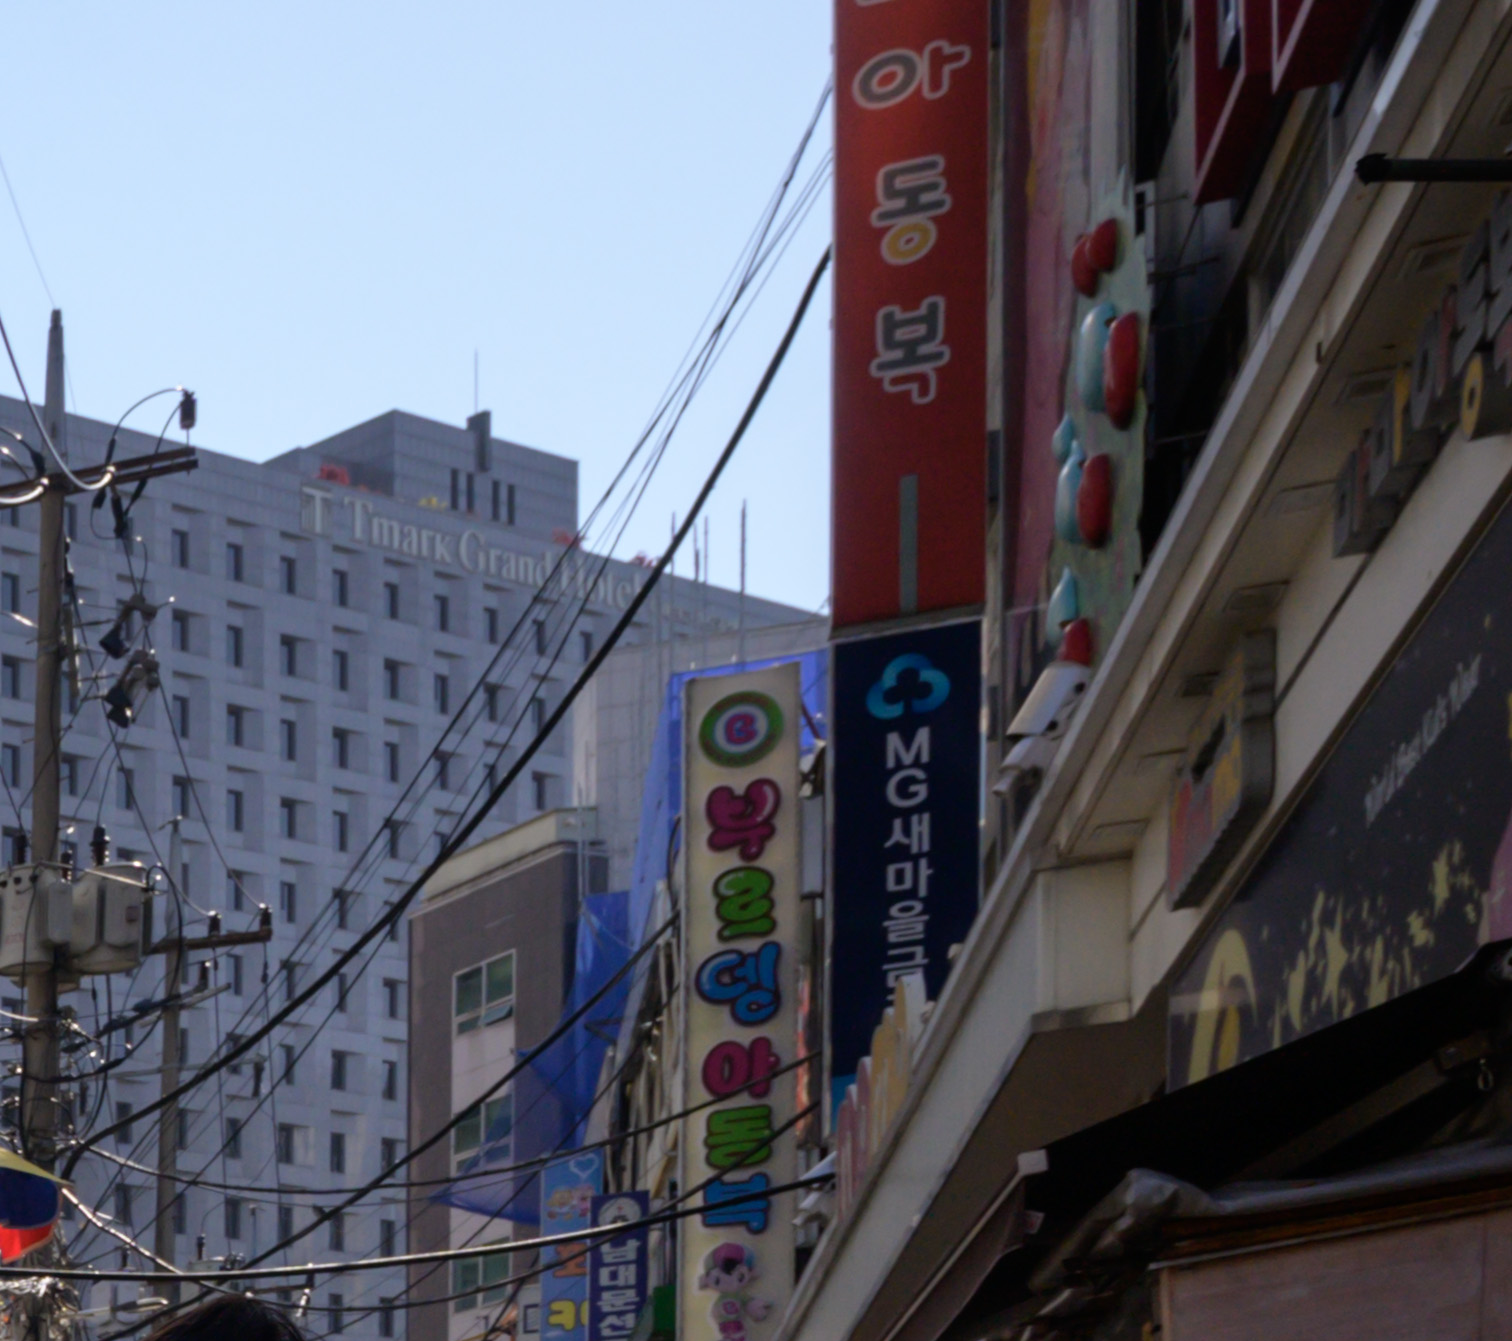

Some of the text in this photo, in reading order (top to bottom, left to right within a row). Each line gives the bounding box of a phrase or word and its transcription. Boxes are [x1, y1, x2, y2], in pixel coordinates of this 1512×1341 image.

[851, 39, 972, 406] 아동복
[345, 495, 454, 565] Tmark
[459, 530, 553, 588] Grand
